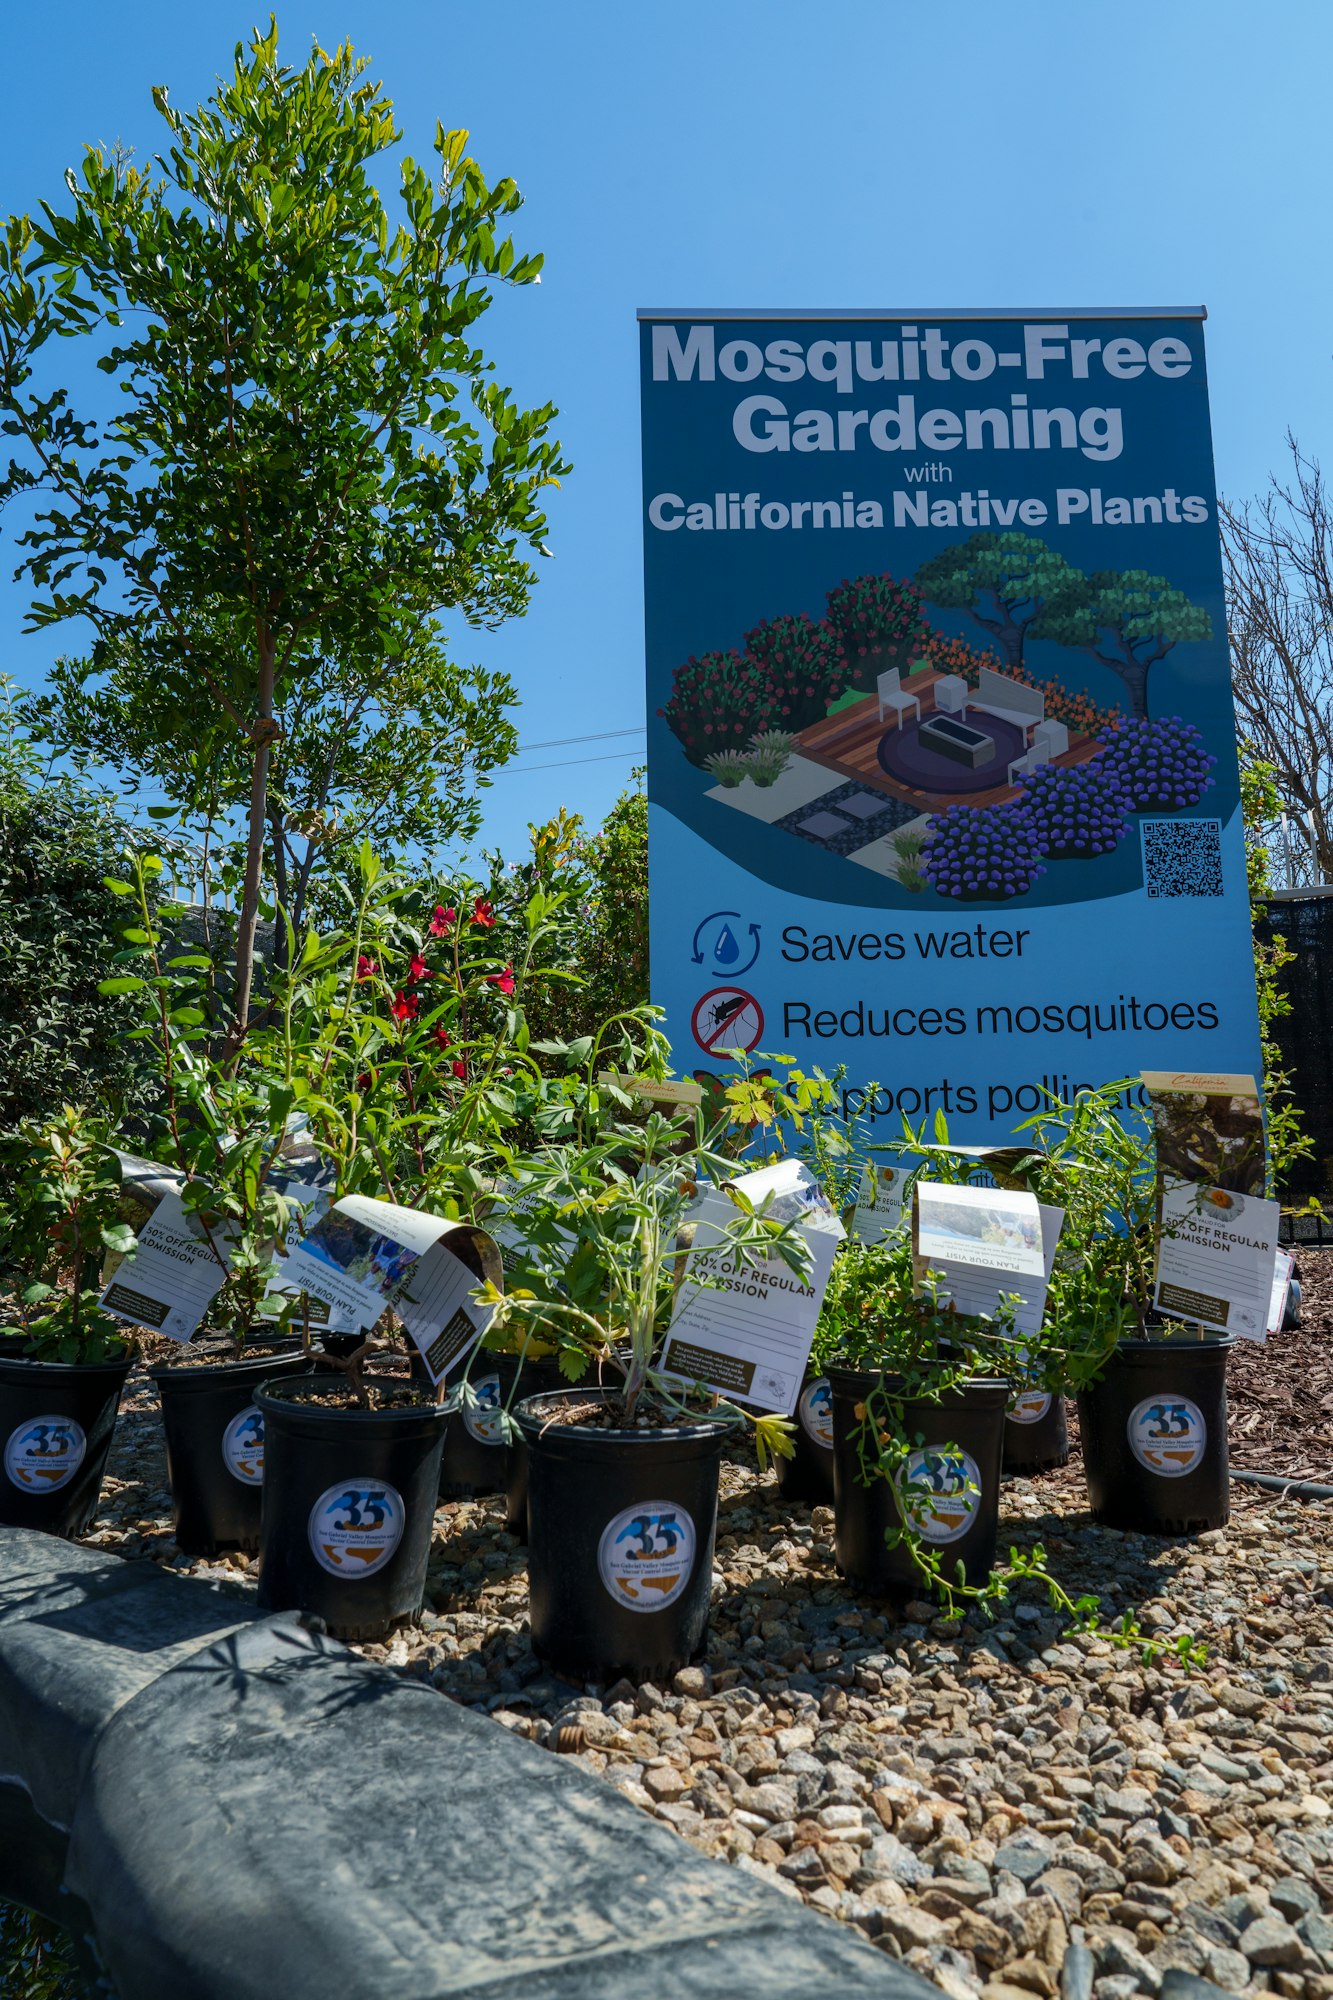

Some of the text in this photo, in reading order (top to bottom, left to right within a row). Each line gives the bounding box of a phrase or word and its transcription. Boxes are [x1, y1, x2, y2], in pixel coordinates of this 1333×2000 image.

[651, 324, 1192, 393] Mosquito-Free
[732, 394, 1124, 461] Gardening
[904, 462, 953, 483] with
[648, 488, 1209, 531] California Native Plants
[781, 923, 1031, 963] Saves water
[783, 995, 1220, 1039] Reduces mosquitoes
[140, 1237, 195, 1265] ADMISSION
[145, 1226, 165, 1239] 50%
[165, 1234, 184, 1249] OFF
[1173, 1230, 1231, 1252] DMISSION
[1188, 1223, 1212, 1236] OFF
[1214, 1229, 1269, 1252] REGULAR
[693, 1253, 718, 1270] 50%
[751, 1270, 817, 1299] REGULAR
[945, 1251, 1019, 1270] PLAN YOUR VISIT
[297, 1274, 316, 1290] VISIT
[314, 1285, 337, 1303] YOUR
[334, 1298, 356, 1315] PLAN
[1148, 1404, 1190, 1438] 35
[25, 1424, 71, 1457] 35
[920, 1455, 965, 1497] 35
[334, 1490, 386, 1532] 35
[625, 1513, 677, 1560] 35
